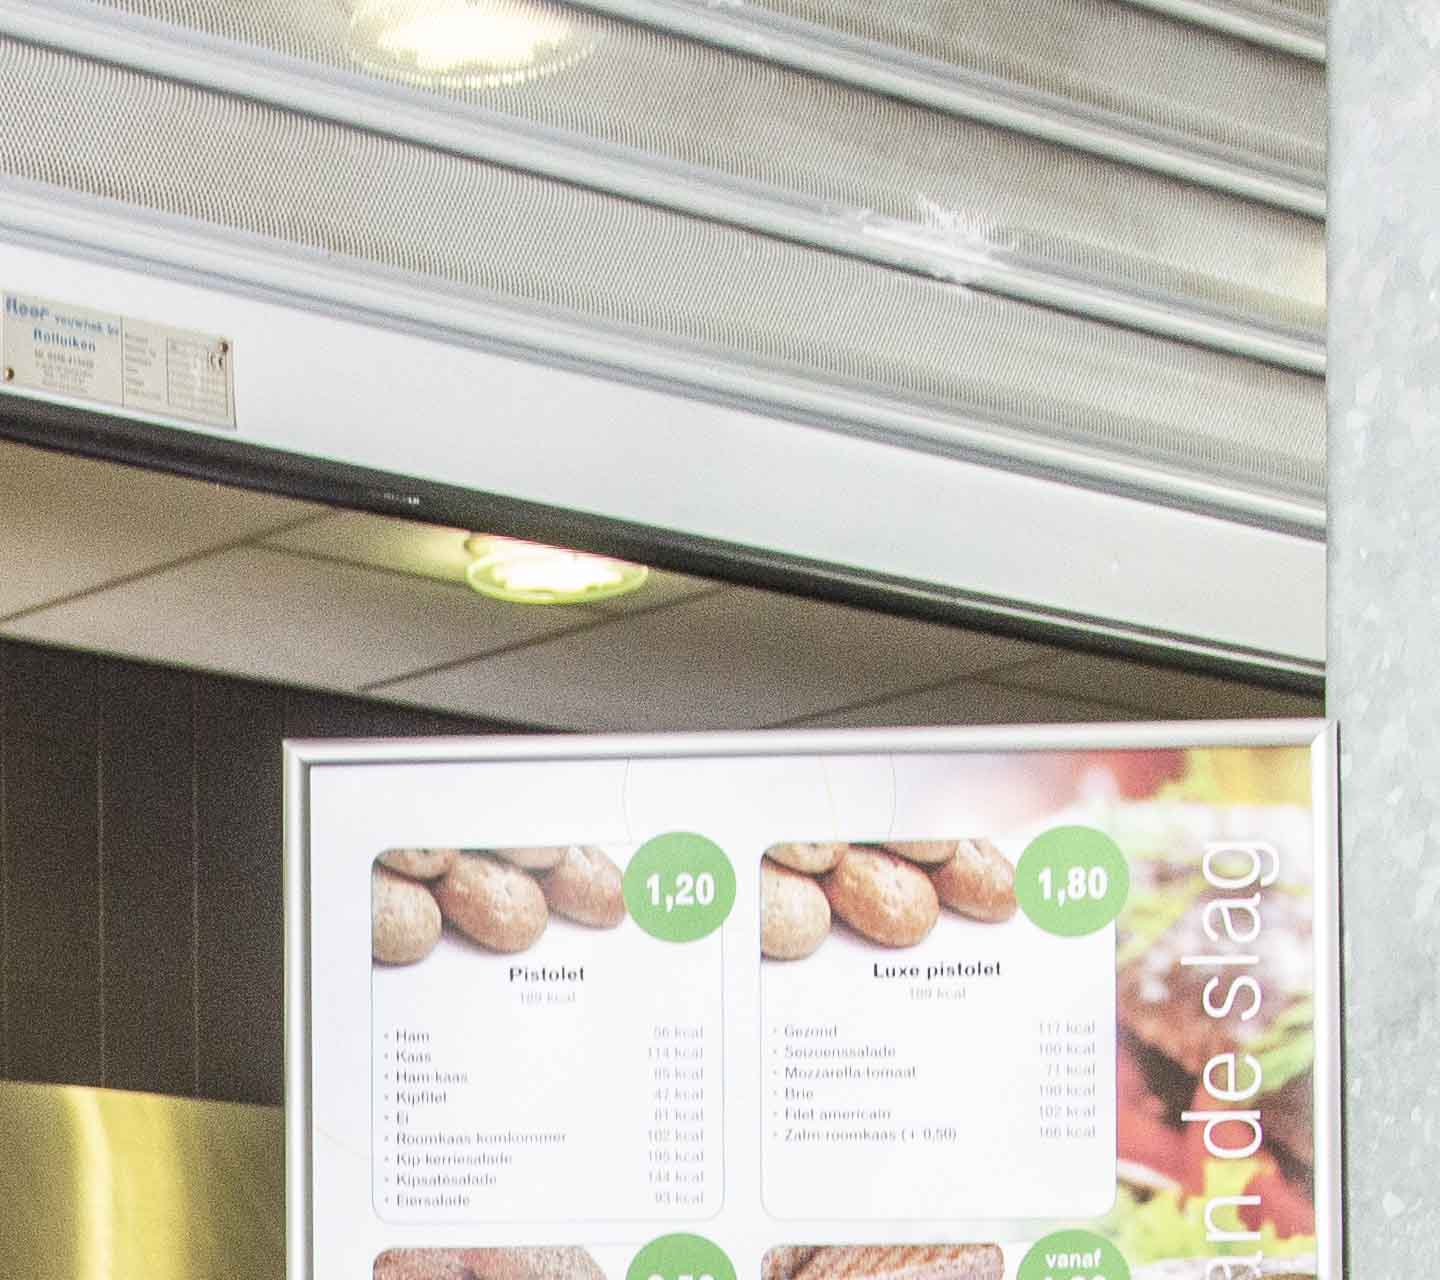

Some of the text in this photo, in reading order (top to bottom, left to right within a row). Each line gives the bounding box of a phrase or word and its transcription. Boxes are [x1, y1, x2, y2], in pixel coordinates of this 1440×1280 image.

[645, 870, 715, 913] 1,20
[1037, 865, 1110, 908] 1,80
[1181, 840, 1279, 1022] slag
[510, 966, 583, 982] Pistolet
[874, 961, 1000, 980] Luxe pistolet
[396, 1029, 429, 1043] Ham
[785, 1024, 837, 1038] Gezond
[396, 1050, 431, 1063] Kaas
[397, 1091, 446, 1106] Kipfilet
[785, 1088, 813, 1100] Brie
[1181, 1049, 1262, 1158] de
[785, 1107, 890, 1120] Filet americain
[397, 1193, 469, 1208] Eiersalade
[1046, 1251, 1102, 1268] vanaf
